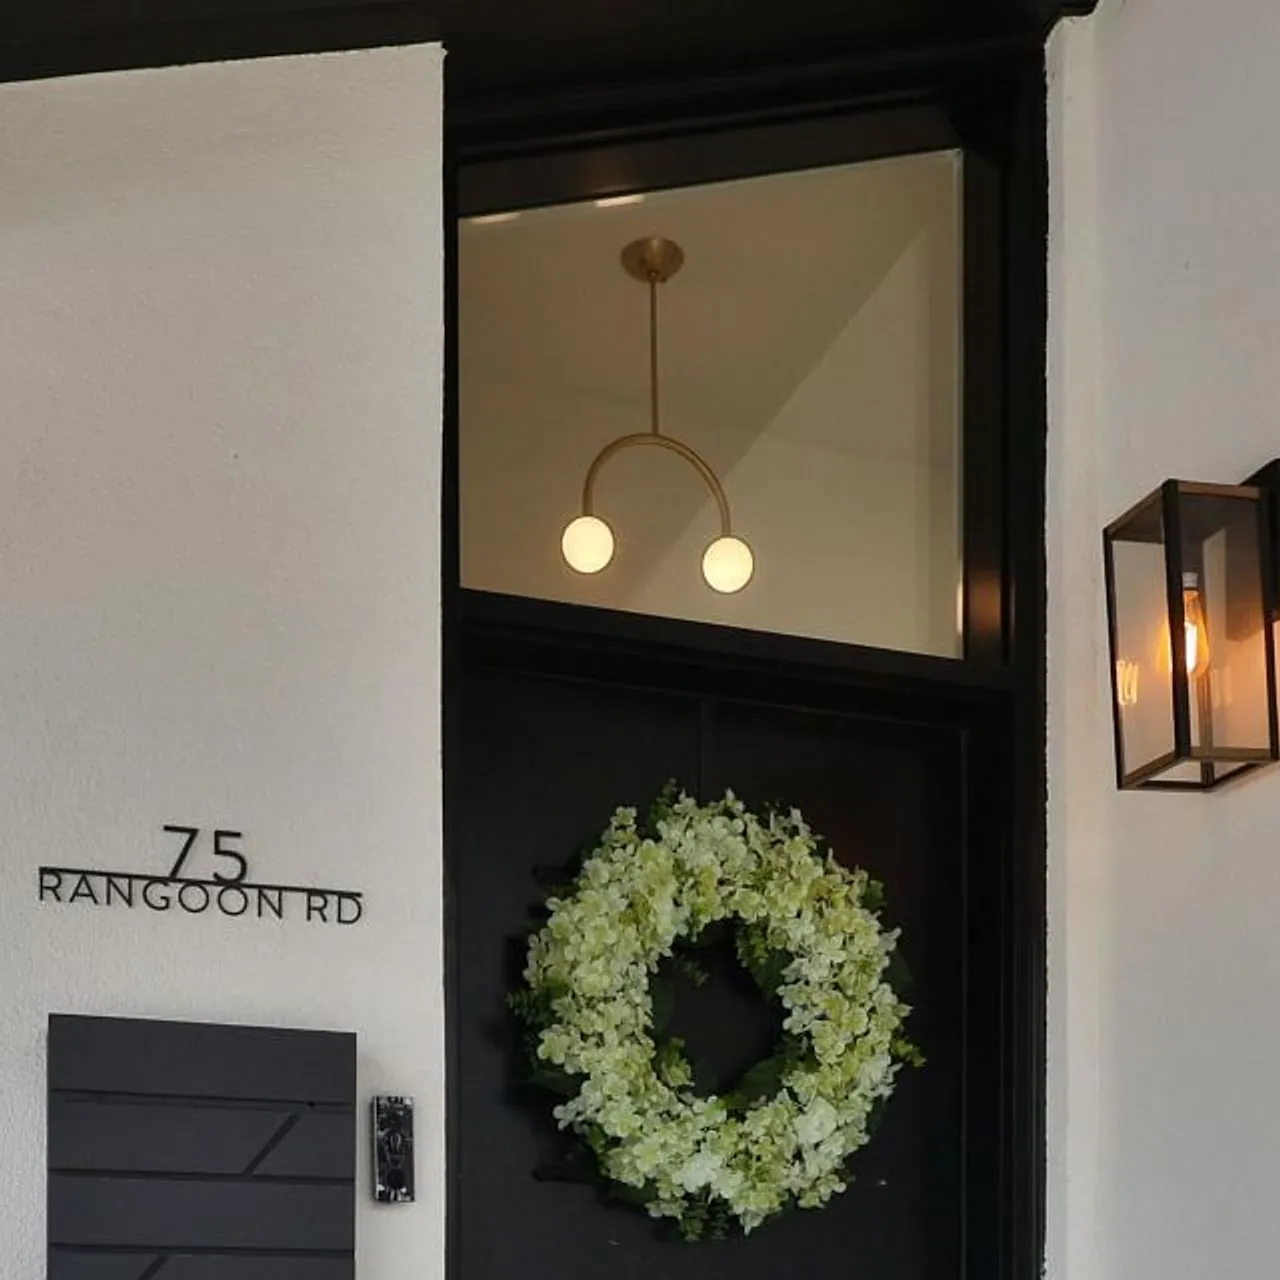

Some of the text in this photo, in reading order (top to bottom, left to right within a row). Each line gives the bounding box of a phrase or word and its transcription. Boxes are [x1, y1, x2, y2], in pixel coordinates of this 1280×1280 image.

[163, 825, 248, 885] 75
[38, 869, 363, 925] RANGOON RD
